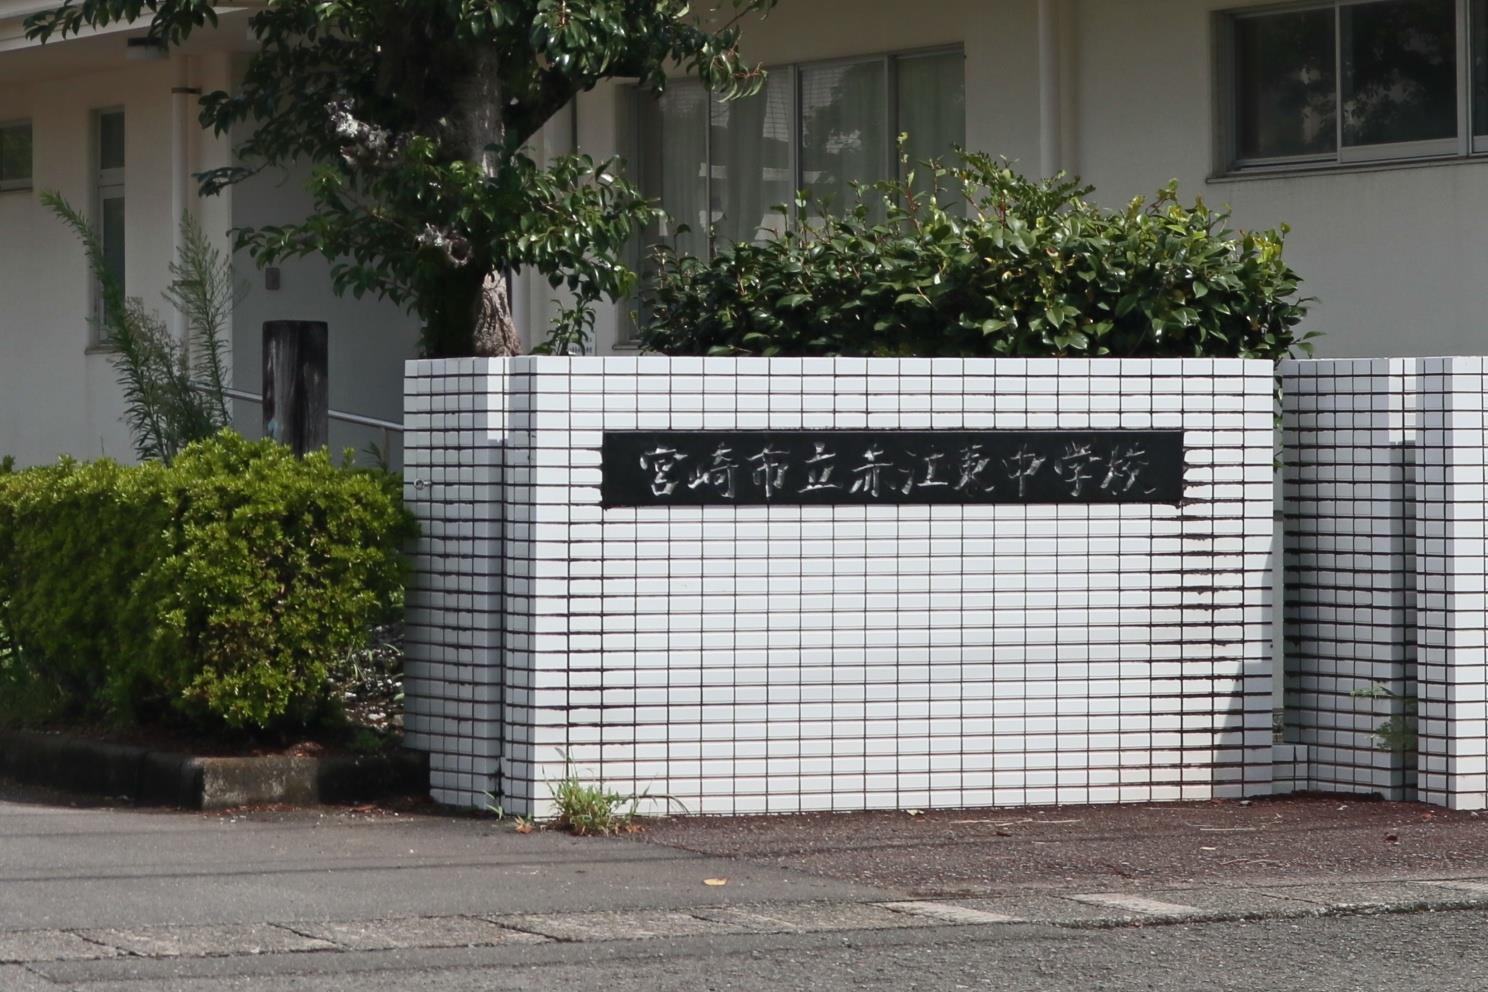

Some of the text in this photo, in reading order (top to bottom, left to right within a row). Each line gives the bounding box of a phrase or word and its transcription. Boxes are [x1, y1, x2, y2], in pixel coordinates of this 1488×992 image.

[640, 441, 1157, 498] 宮崎市立赤江東中学校
